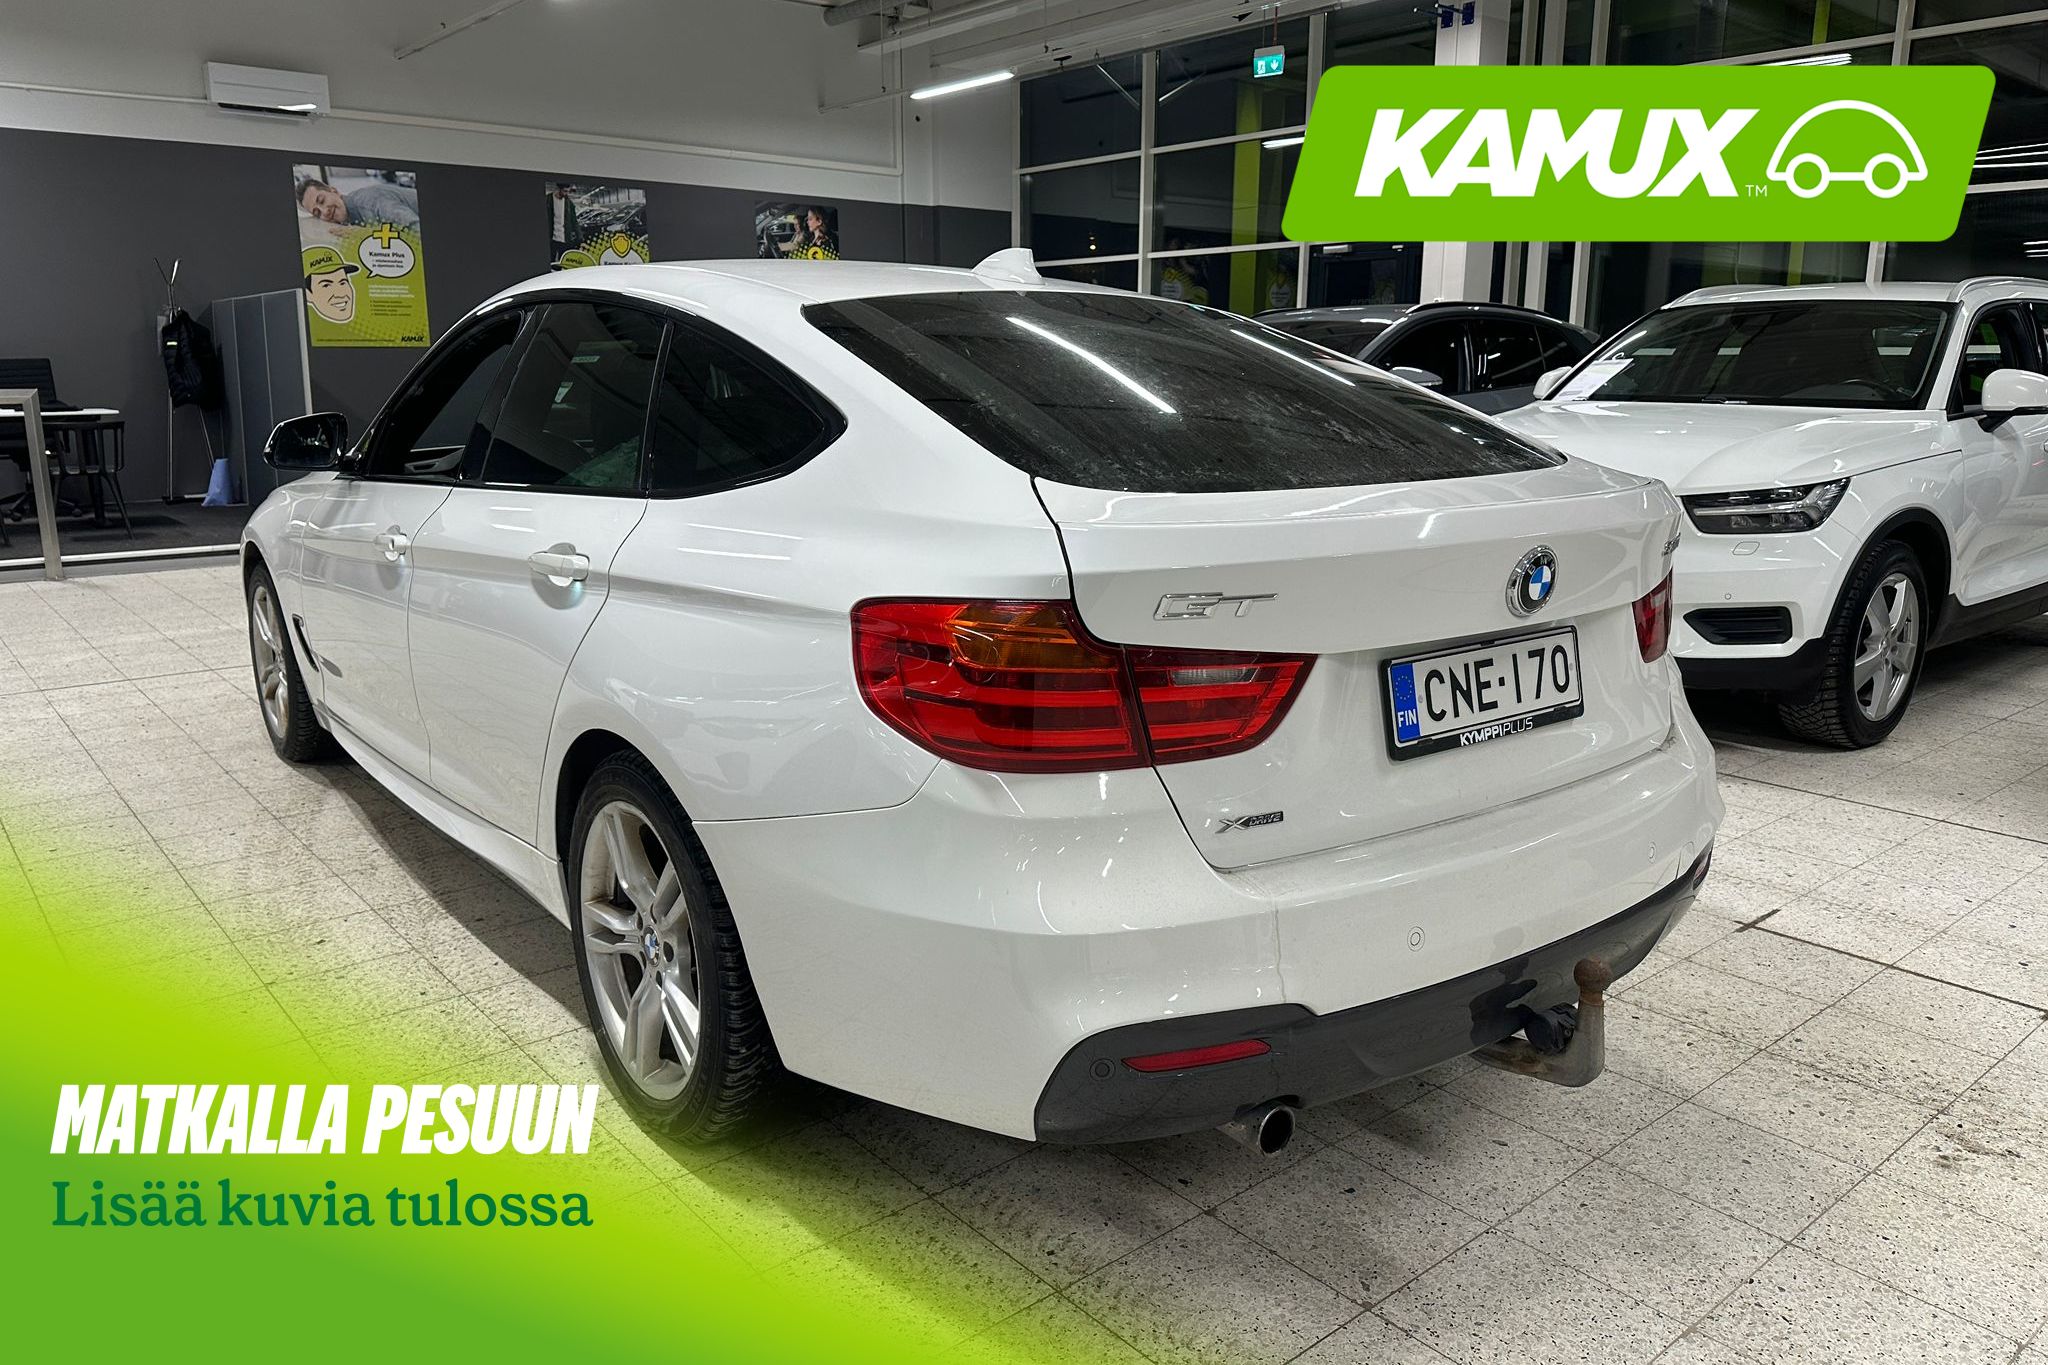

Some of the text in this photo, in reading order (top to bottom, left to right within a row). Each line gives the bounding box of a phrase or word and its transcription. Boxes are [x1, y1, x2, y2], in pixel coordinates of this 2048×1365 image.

[1153, 592, 1278, 621] GT
[1424, 645, 1570, 722] CNE-170
[1397, 708, 1417, 728] FIN
[1459, 717, 1533, 746] KYMPPIPLUS
